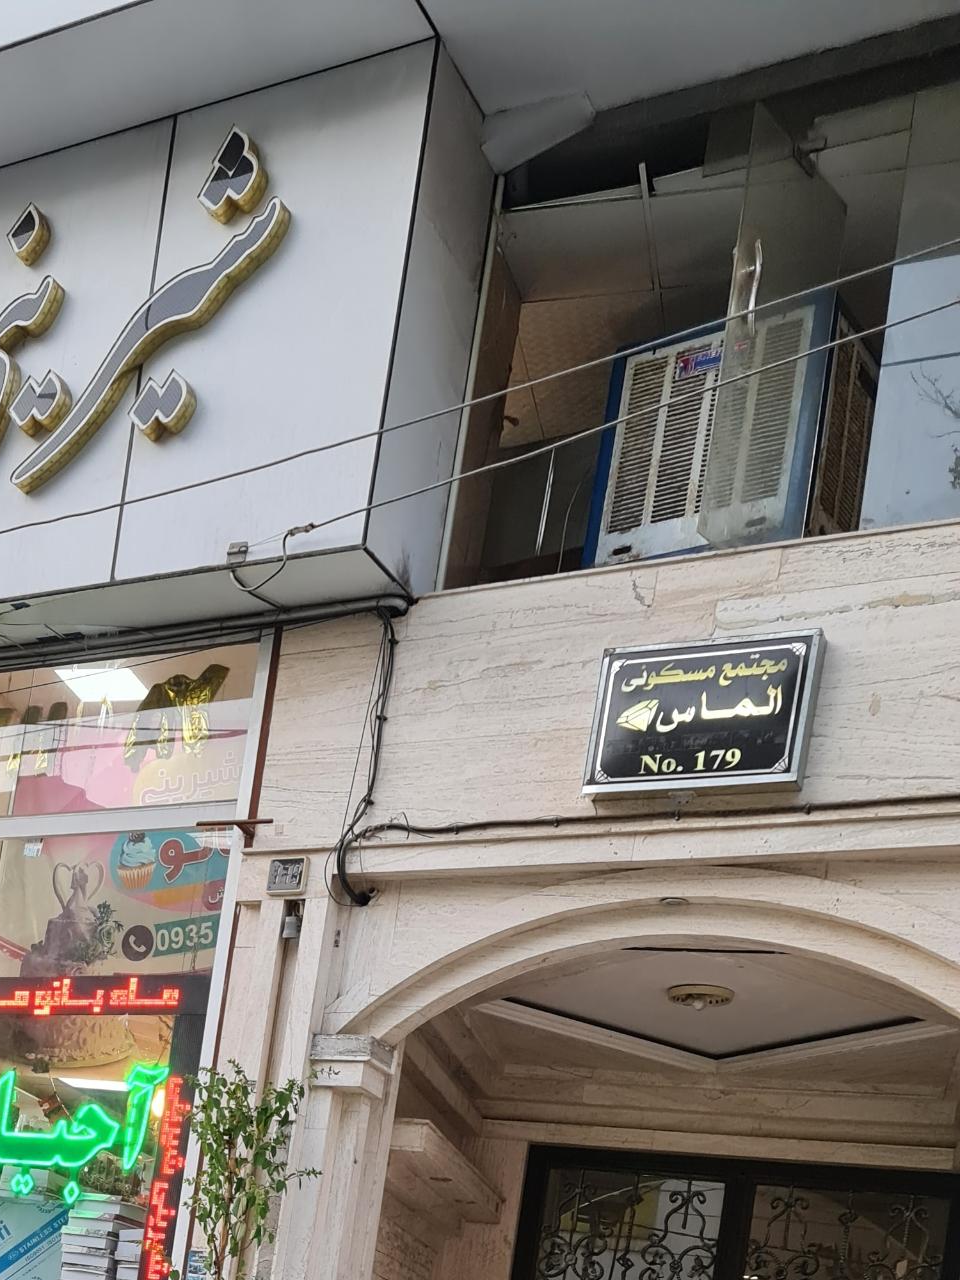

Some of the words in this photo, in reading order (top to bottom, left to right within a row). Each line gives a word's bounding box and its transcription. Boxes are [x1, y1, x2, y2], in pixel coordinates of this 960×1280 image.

[621, 662, 716, 693] مسکونی
[718, 652, 789, 687] مجتمع
[655, 683, 784, 734] الماس
[639, 753, 685, 775] No.
[693, 747, 743, 772] 179
[157, 922, 213, 951] 0935
[34, 978, 104, 1016] بانو
[110, 977, 180, 1007] ماه
